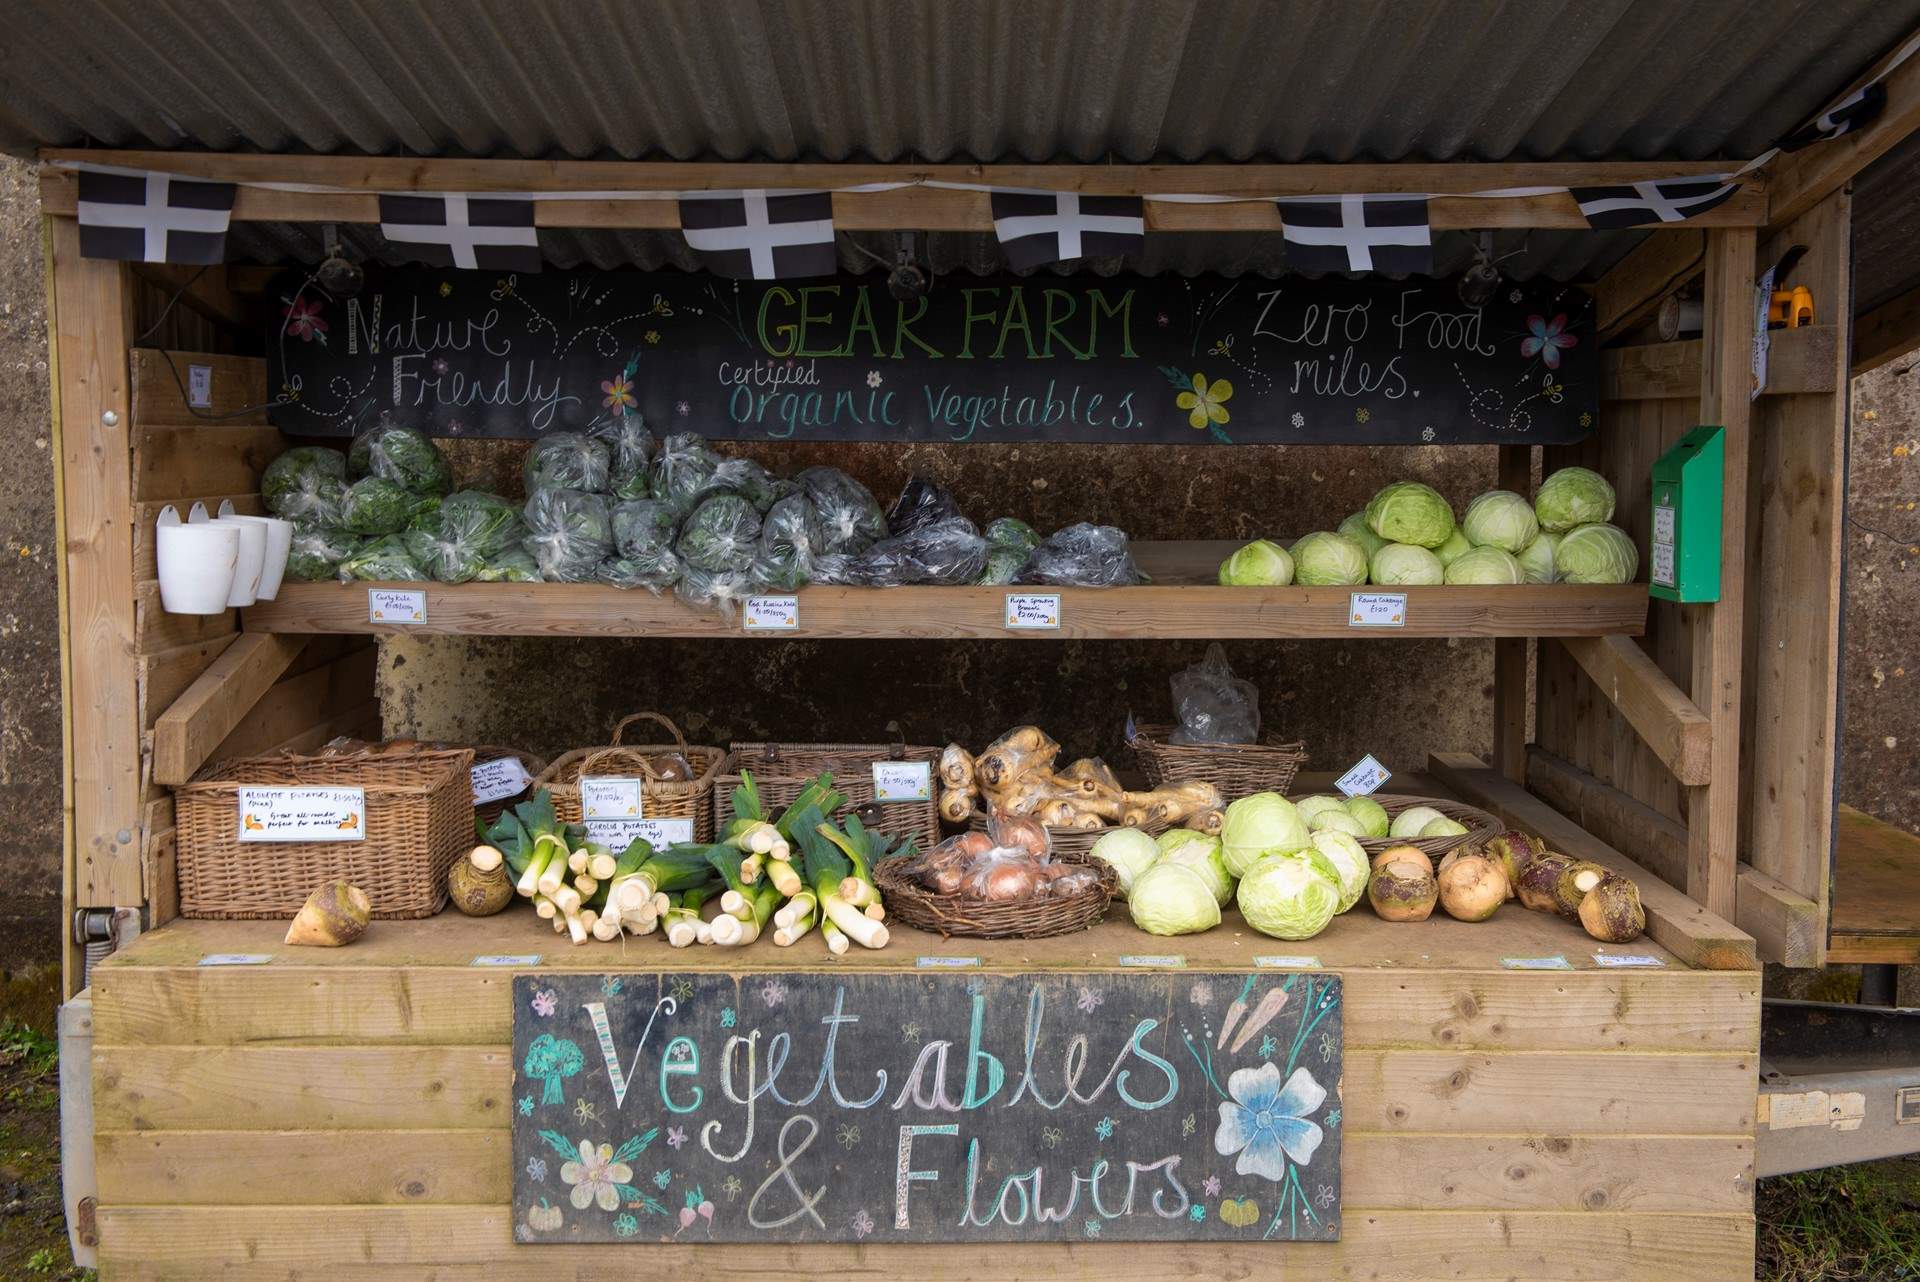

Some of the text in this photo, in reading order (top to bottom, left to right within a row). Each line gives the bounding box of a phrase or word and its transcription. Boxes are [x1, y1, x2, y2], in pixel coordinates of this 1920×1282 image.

[348, 294, 510, 356] Nature
[757, 285, 1140, 360] GEAR FARM
[1252, 288, 1496, 356] Zero Food
[719, 358, 820, 393] Certified
[729, 384, 901, 439] Organic
[582, 983, 1179, 1163] Vegetables
[747, 1113, 1192, 1232] & Flowers
